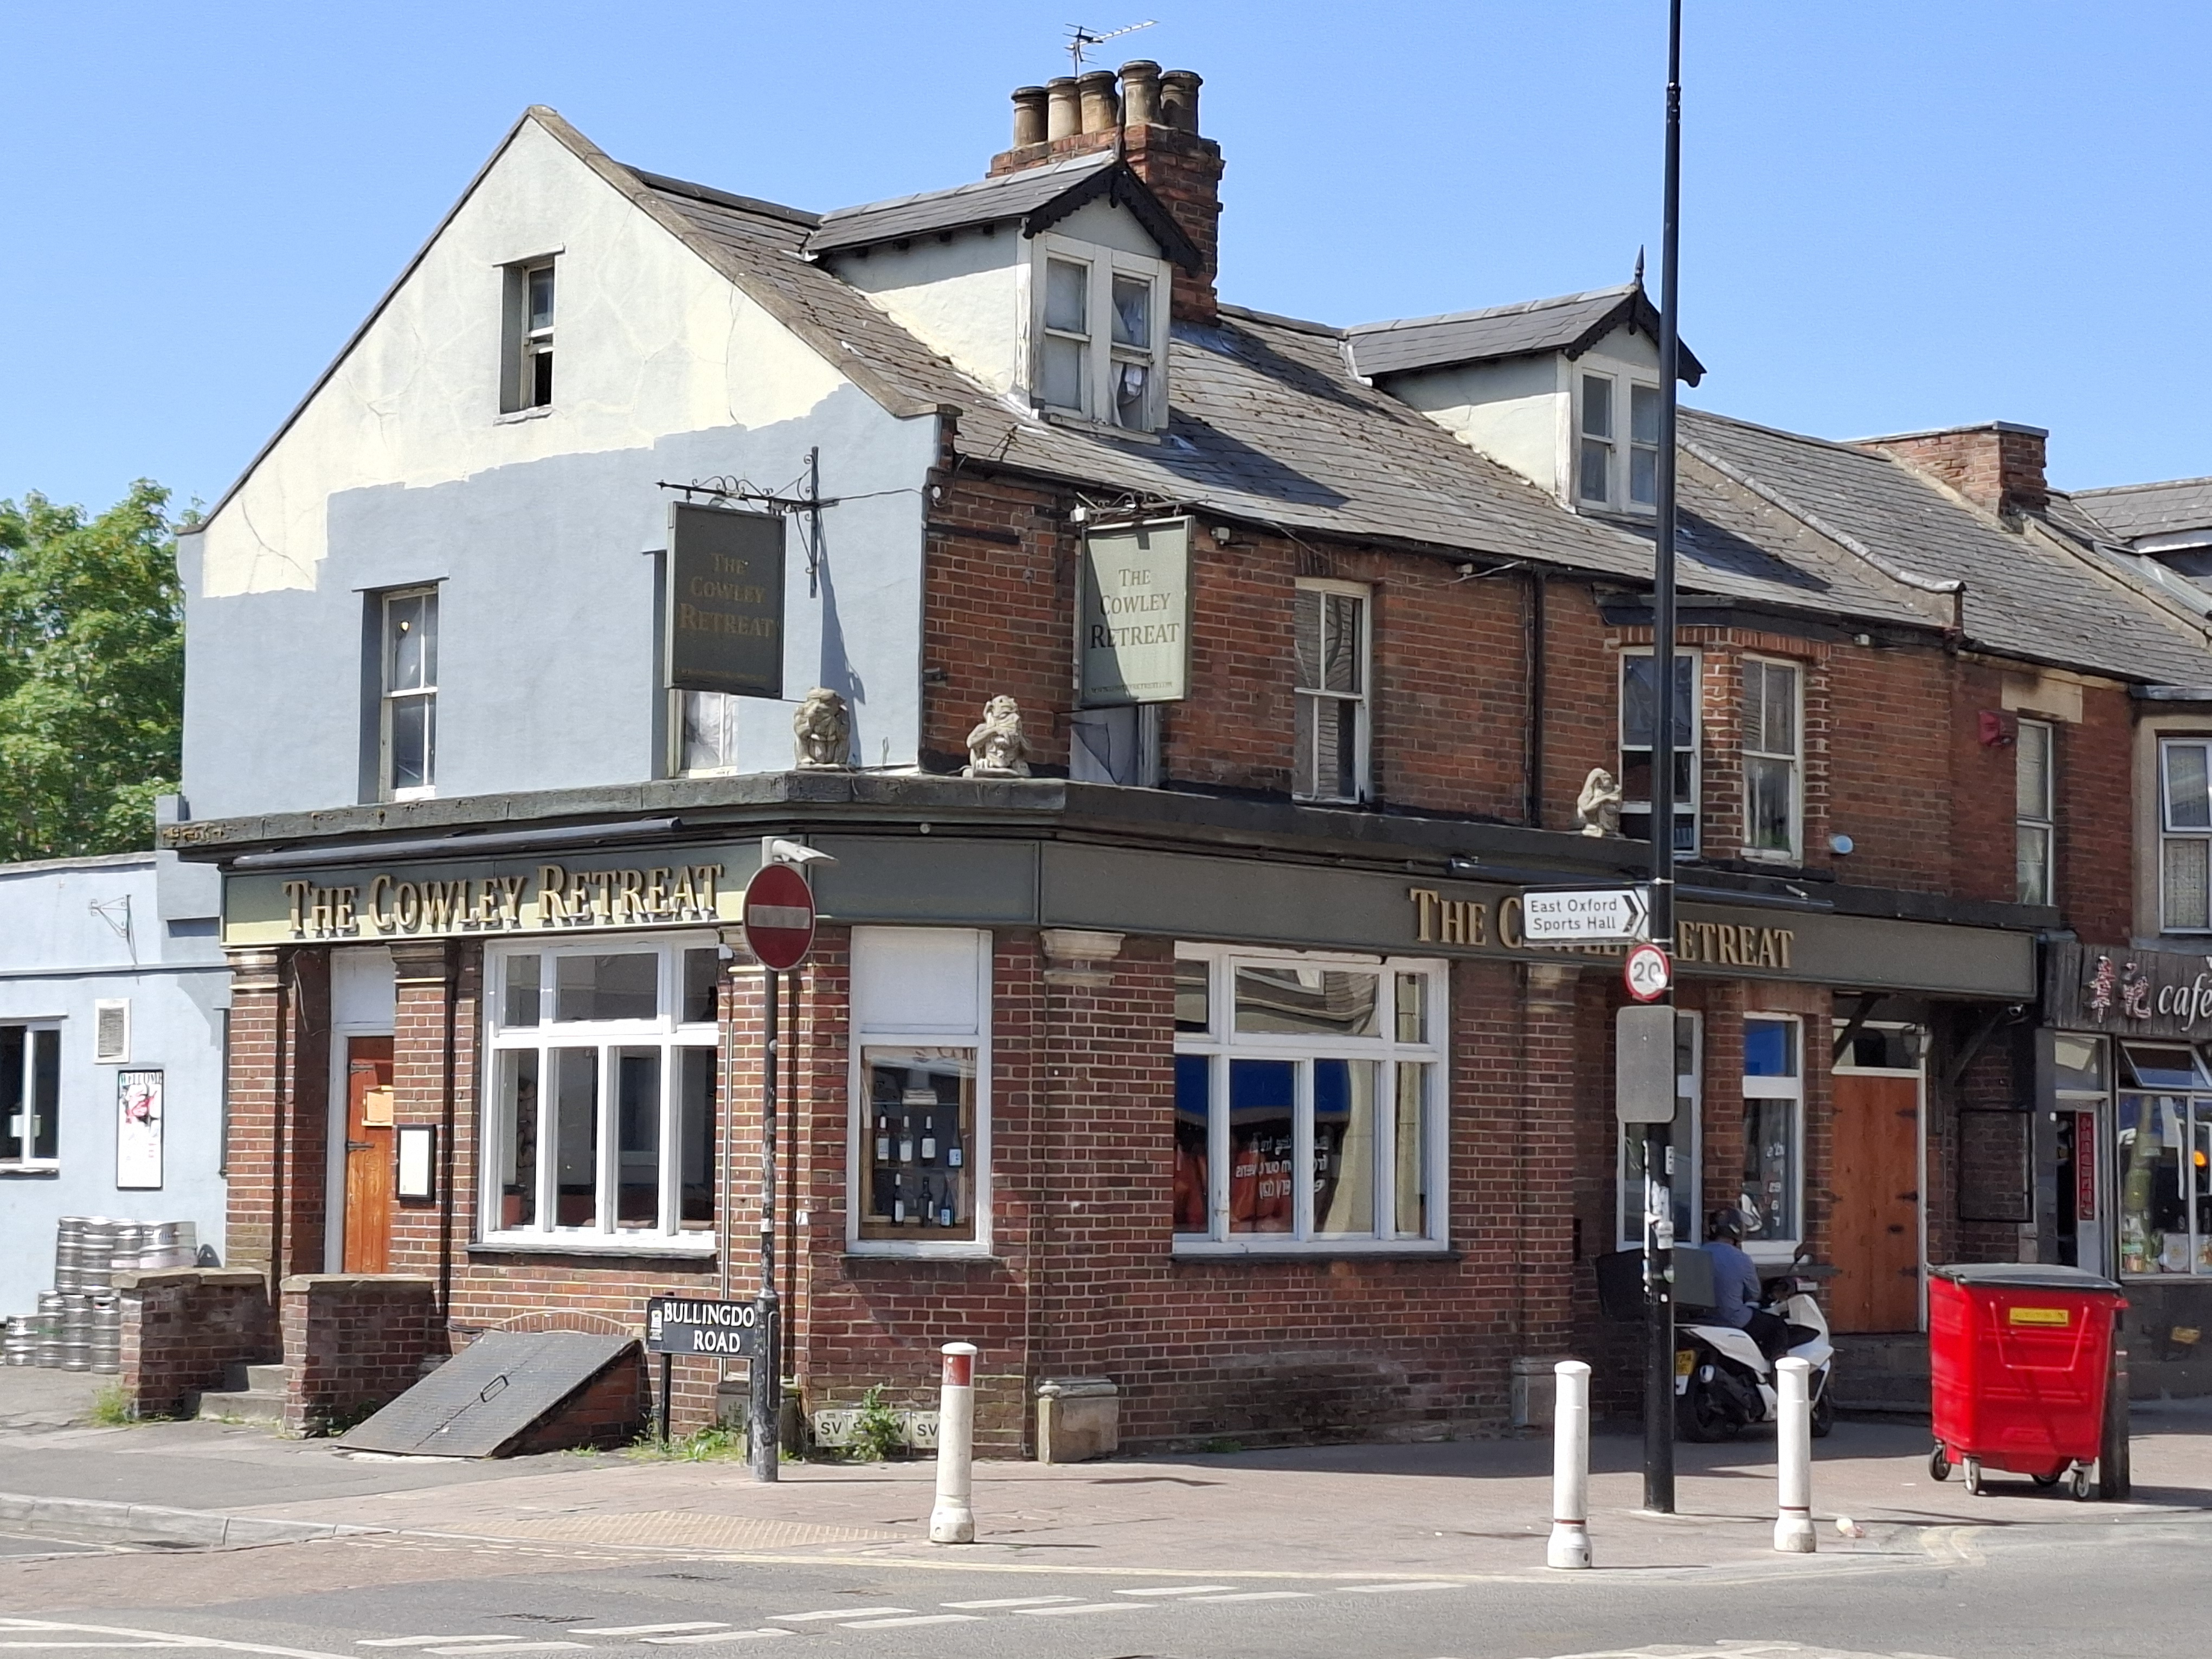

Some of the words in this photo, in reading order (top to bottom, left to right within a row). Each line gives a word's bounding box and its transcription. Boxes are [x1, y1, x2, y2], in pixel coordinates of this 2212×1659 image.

[710, 554, 747, 574] THE
[691, 576, 766, 603] COWLEY
[1118, 569, 1151, 587] THE
[1099, 593, 1171, 616] COWLEY
[680, 603, 774, 637] RETREAT
[1090, 623, 1180, 649] RETREAT
[282, 879, 357, 933] THE
[369, 873, 525, 929] COWLEY
[536, 863, 725, 920] RETREAT
[1531, 900, 1562, 912] East
[1567, 898, 1617, 912] Oxford
[1410, 888, 1487, 946] THE
[1673, 919, 1794, 969] ETREAT
[1533, 917, 1580, 933] Sports
[1587, 916, 1616, 930] Hall
[1633, 961, 1662, 982] 20
[663, 1302, 755, 1327] BULLINGDO
[693, 1329, 741, 1353] ROAD
[820, 1422, 841, 1435] SV
[917, 1423, 938, 1437] SV
